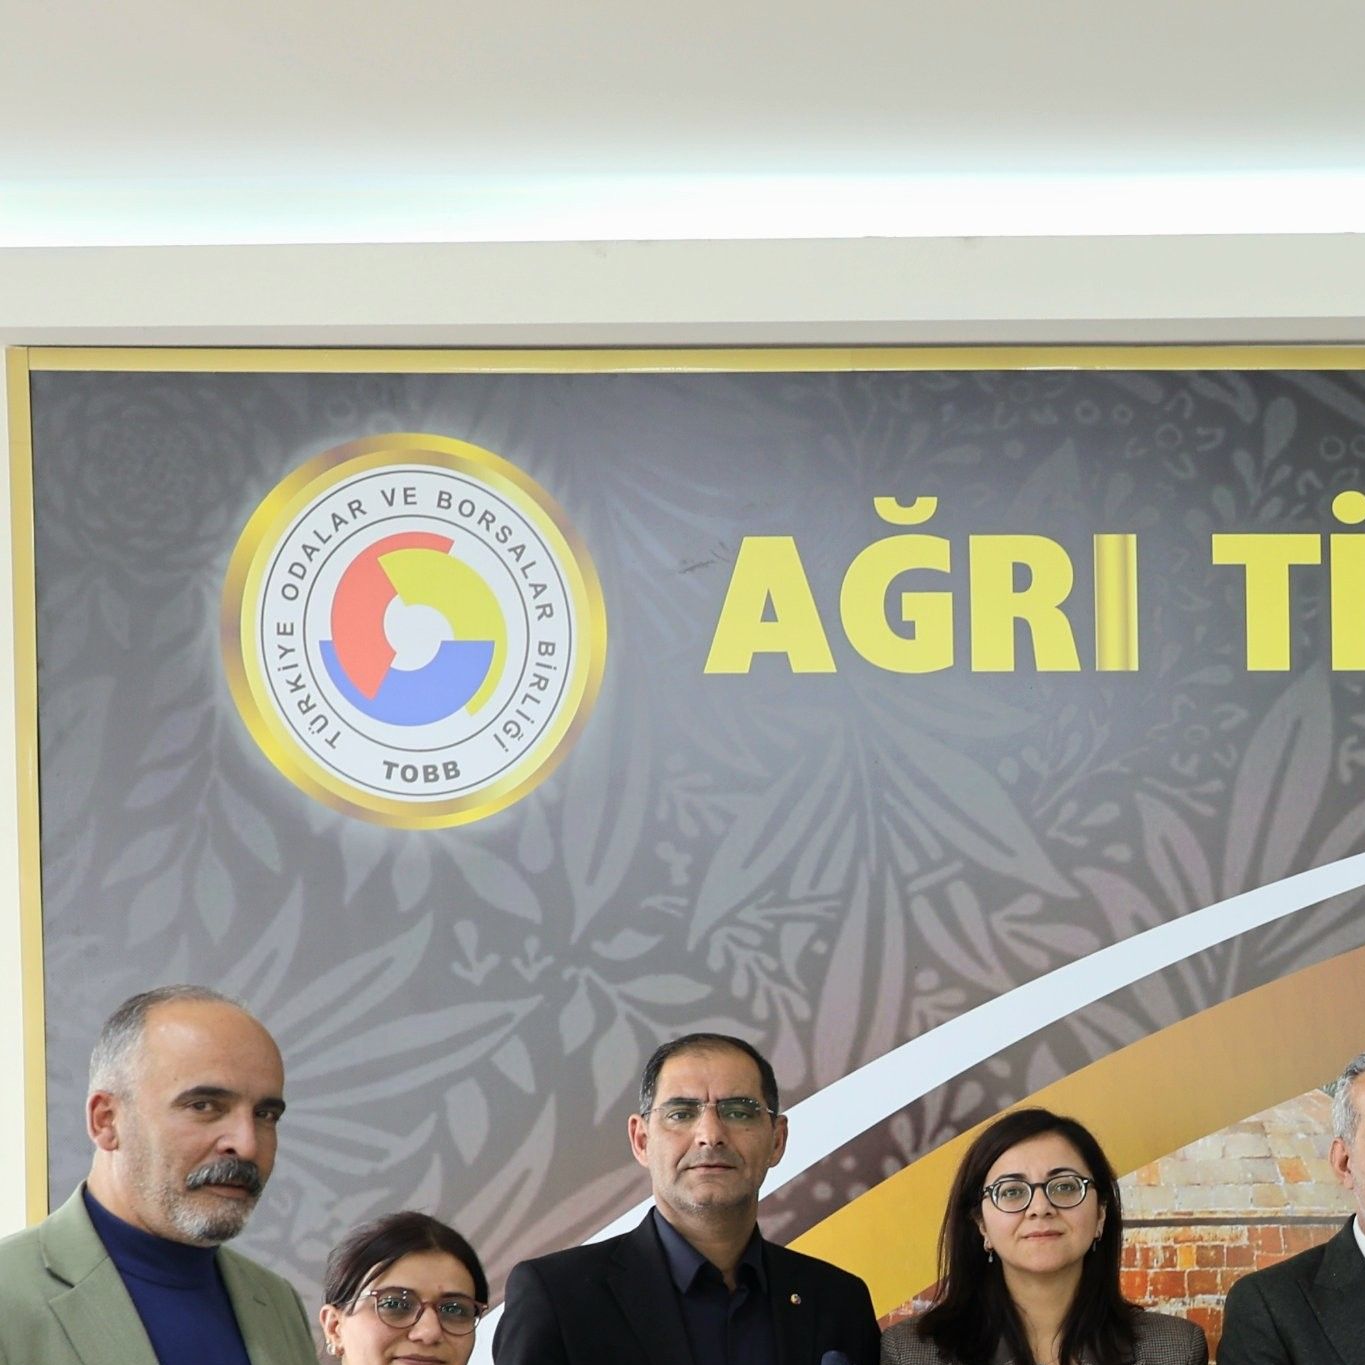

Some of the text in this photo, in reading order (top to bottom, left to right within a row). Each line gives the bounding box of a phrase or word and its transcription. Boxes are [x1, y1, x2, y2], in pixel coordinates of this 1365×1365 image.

[276, 486, 557, 753] TÜRKİYE ODALAR VE BORSALAR BİRLİĞİ
[703, 496, 1139, 674] AĞRI
[382, 760, 461, 784] TOBB
